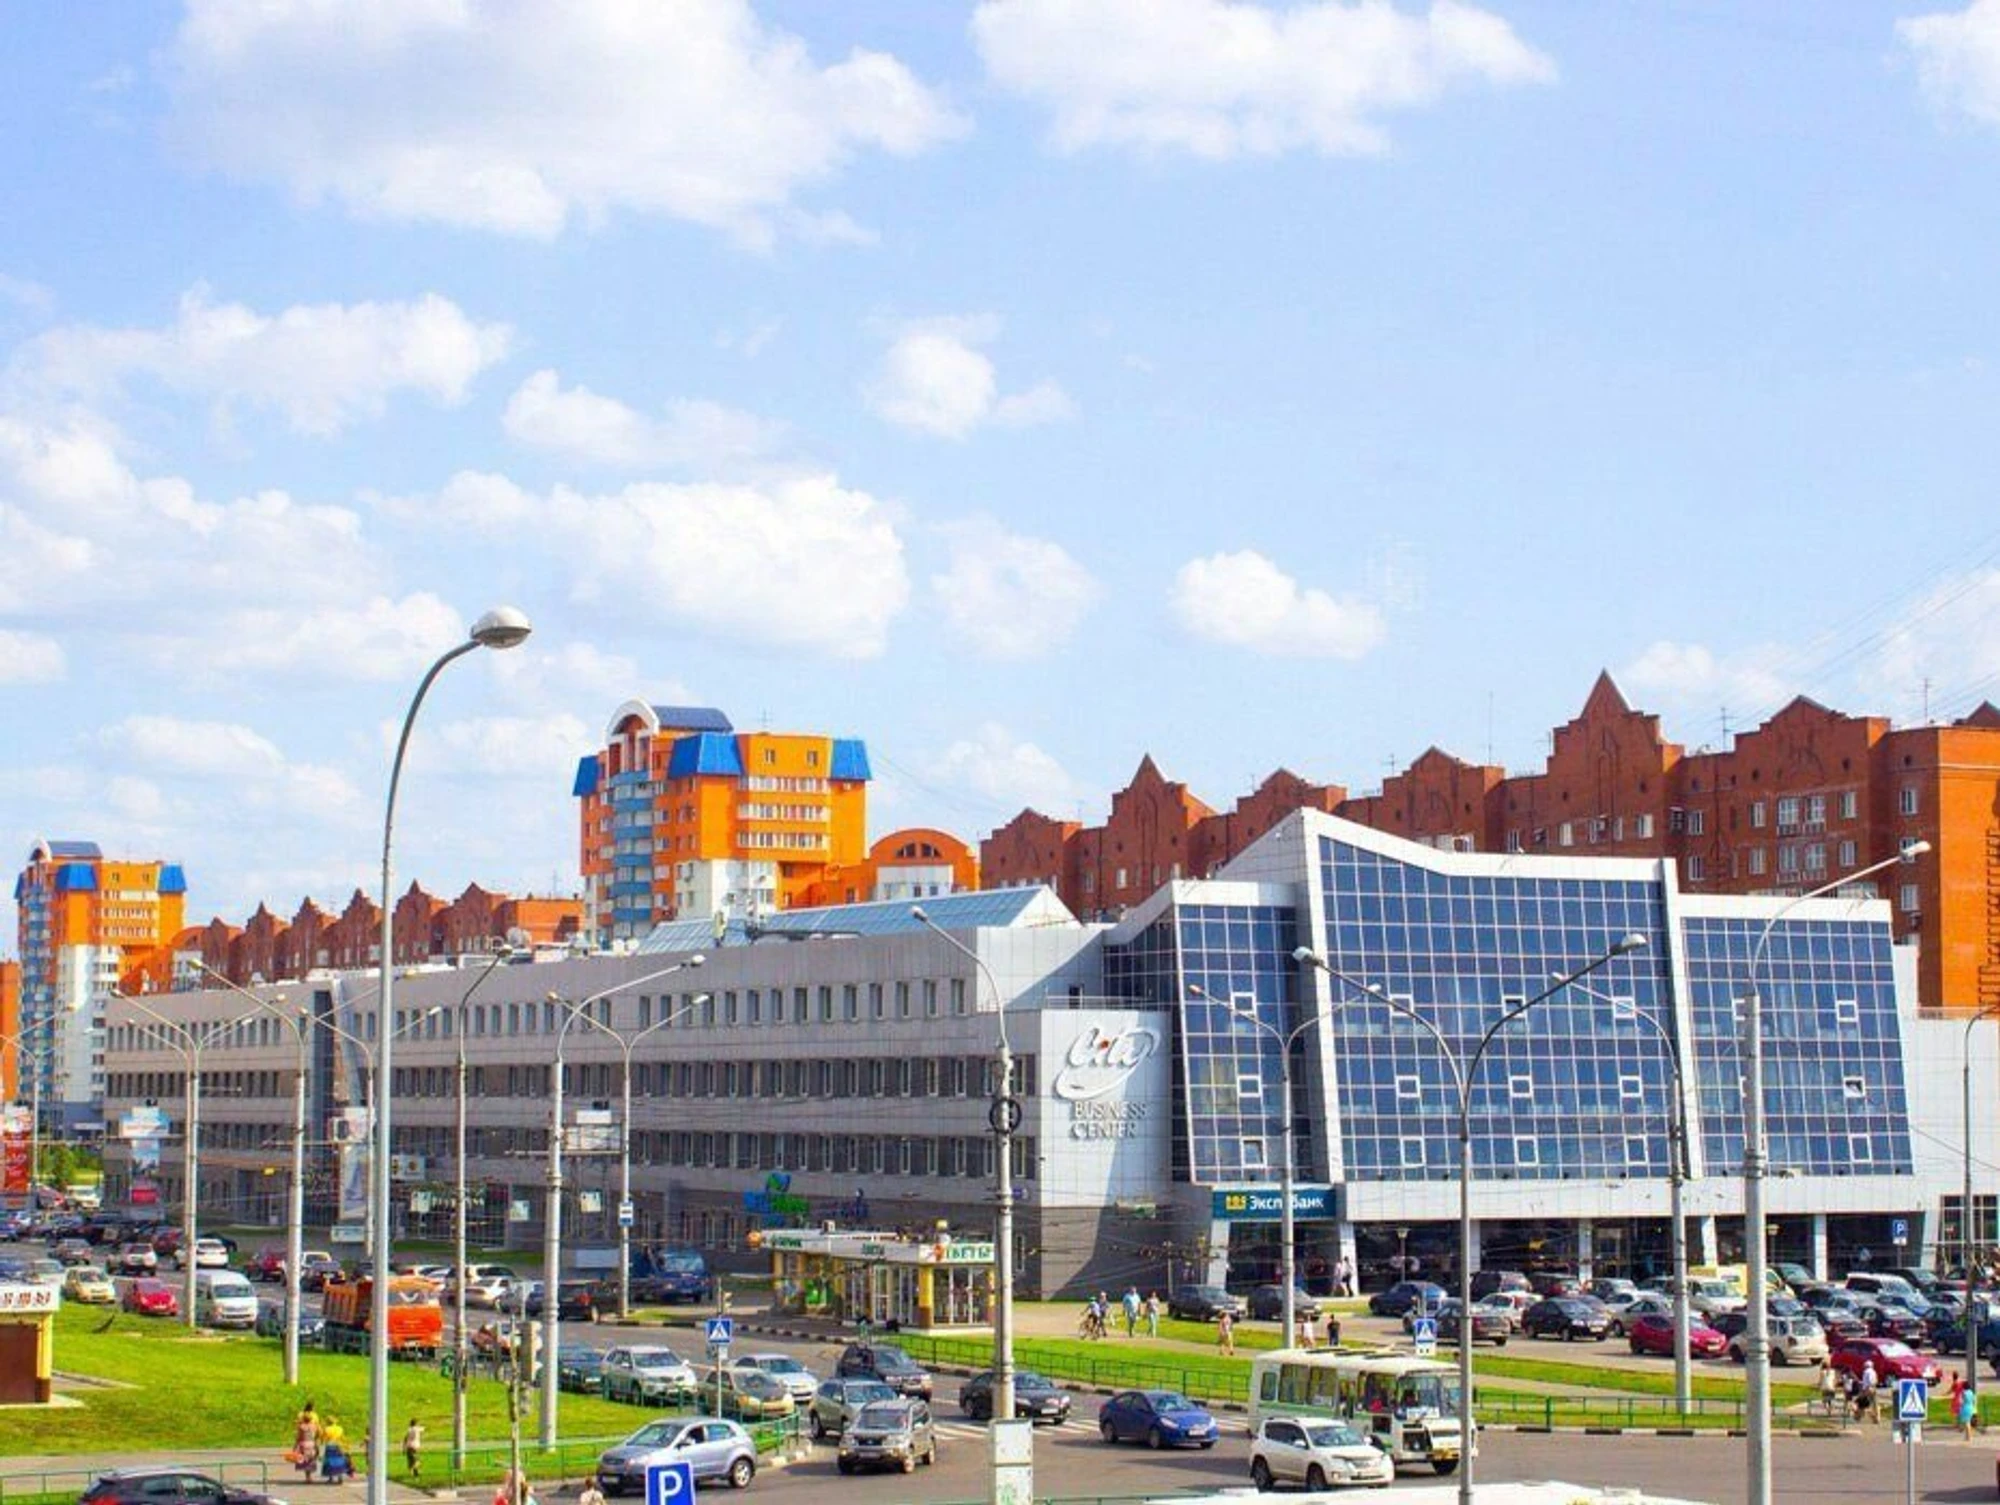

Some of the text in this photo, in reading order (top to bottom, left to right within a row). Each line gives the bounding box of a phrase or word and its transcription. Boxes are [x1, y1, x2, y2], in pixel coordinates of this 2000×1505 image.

[1072, 1100, 1147, 1119] BUSINESS
[1071, 1120, 1136, 1139] CENTER
[1249, 1194, 1324, 1210] Экспбанк
[659, 1470, 683, 1505] P
